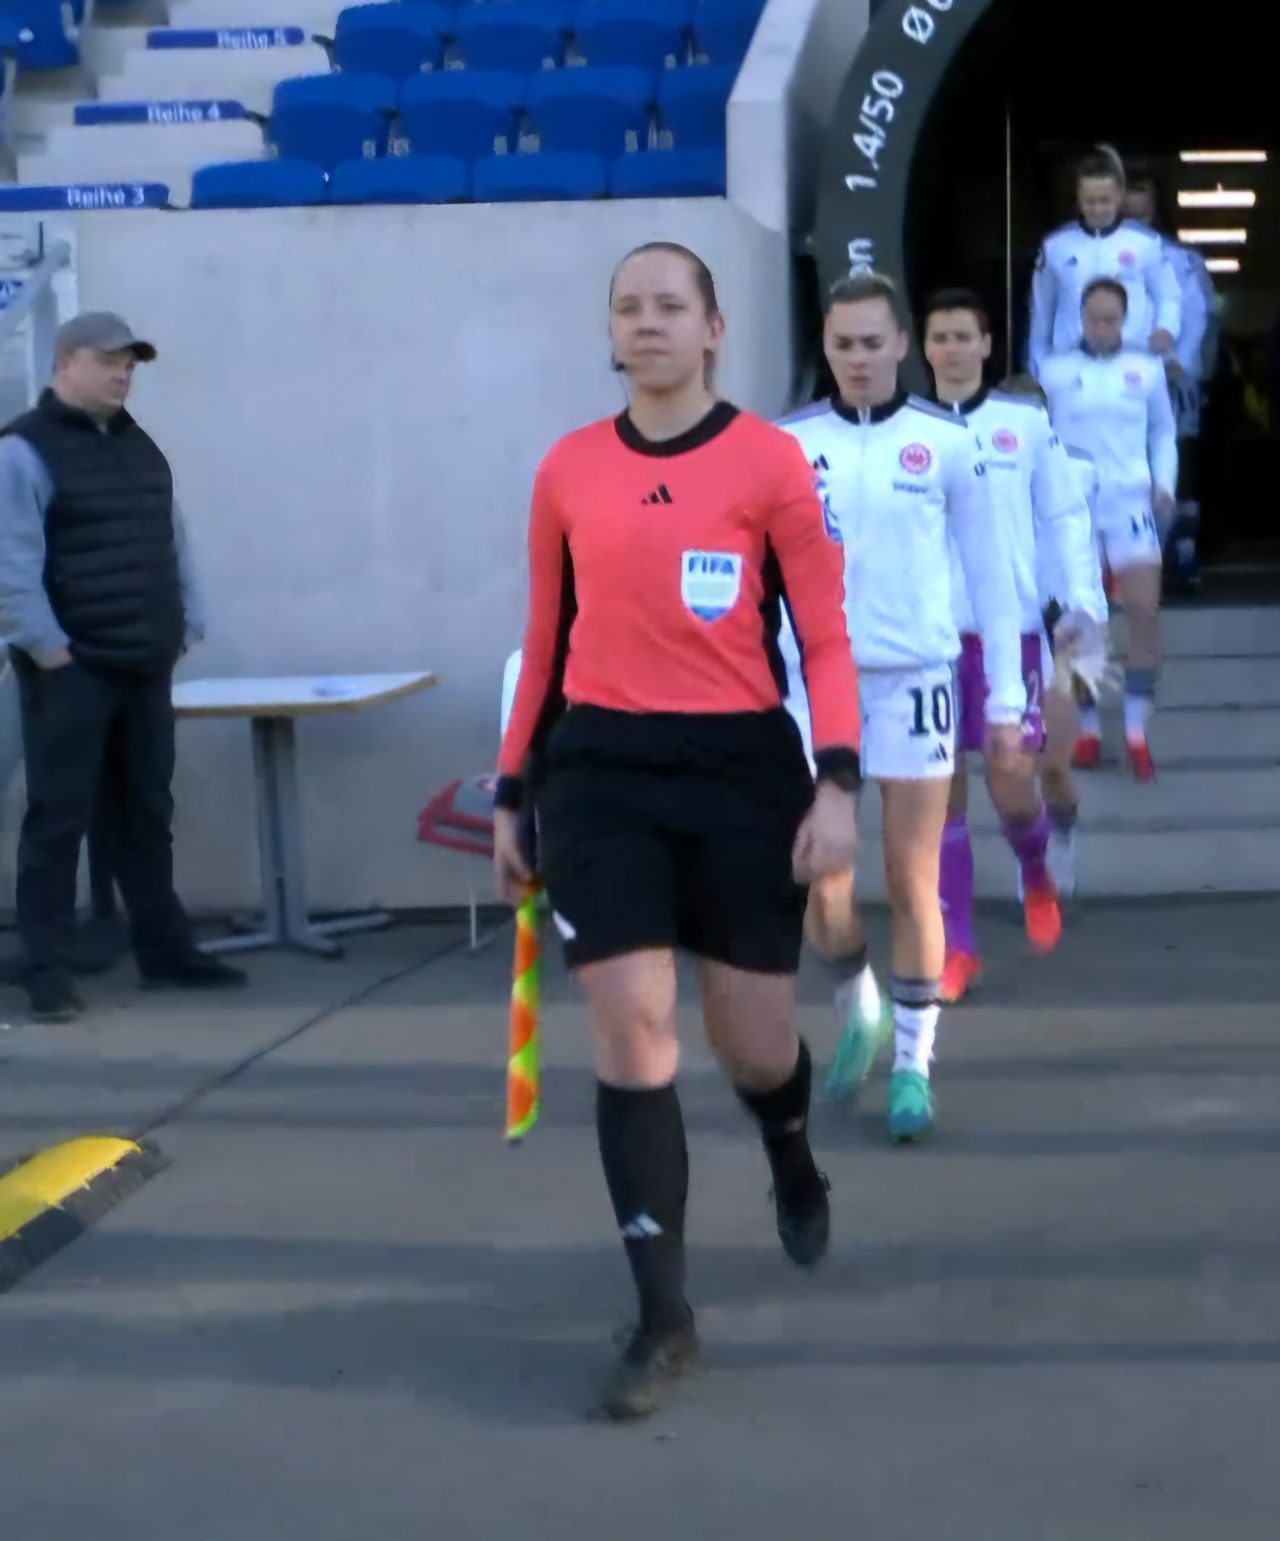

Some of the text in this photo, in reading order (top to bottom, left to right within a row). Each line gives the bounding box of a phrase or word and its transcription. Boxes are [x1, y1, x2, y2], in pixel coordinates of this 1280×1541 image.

[217, 30, 269, 49] Reihe
[148, 102, 220, 123] Reihe 4
[845, 69, 904, 191] 1.4/50
[67, 187, 144, 208] Reihe 3
[688, 556, 735, 575] FIFA
[907, 684, 951, 736] 10
